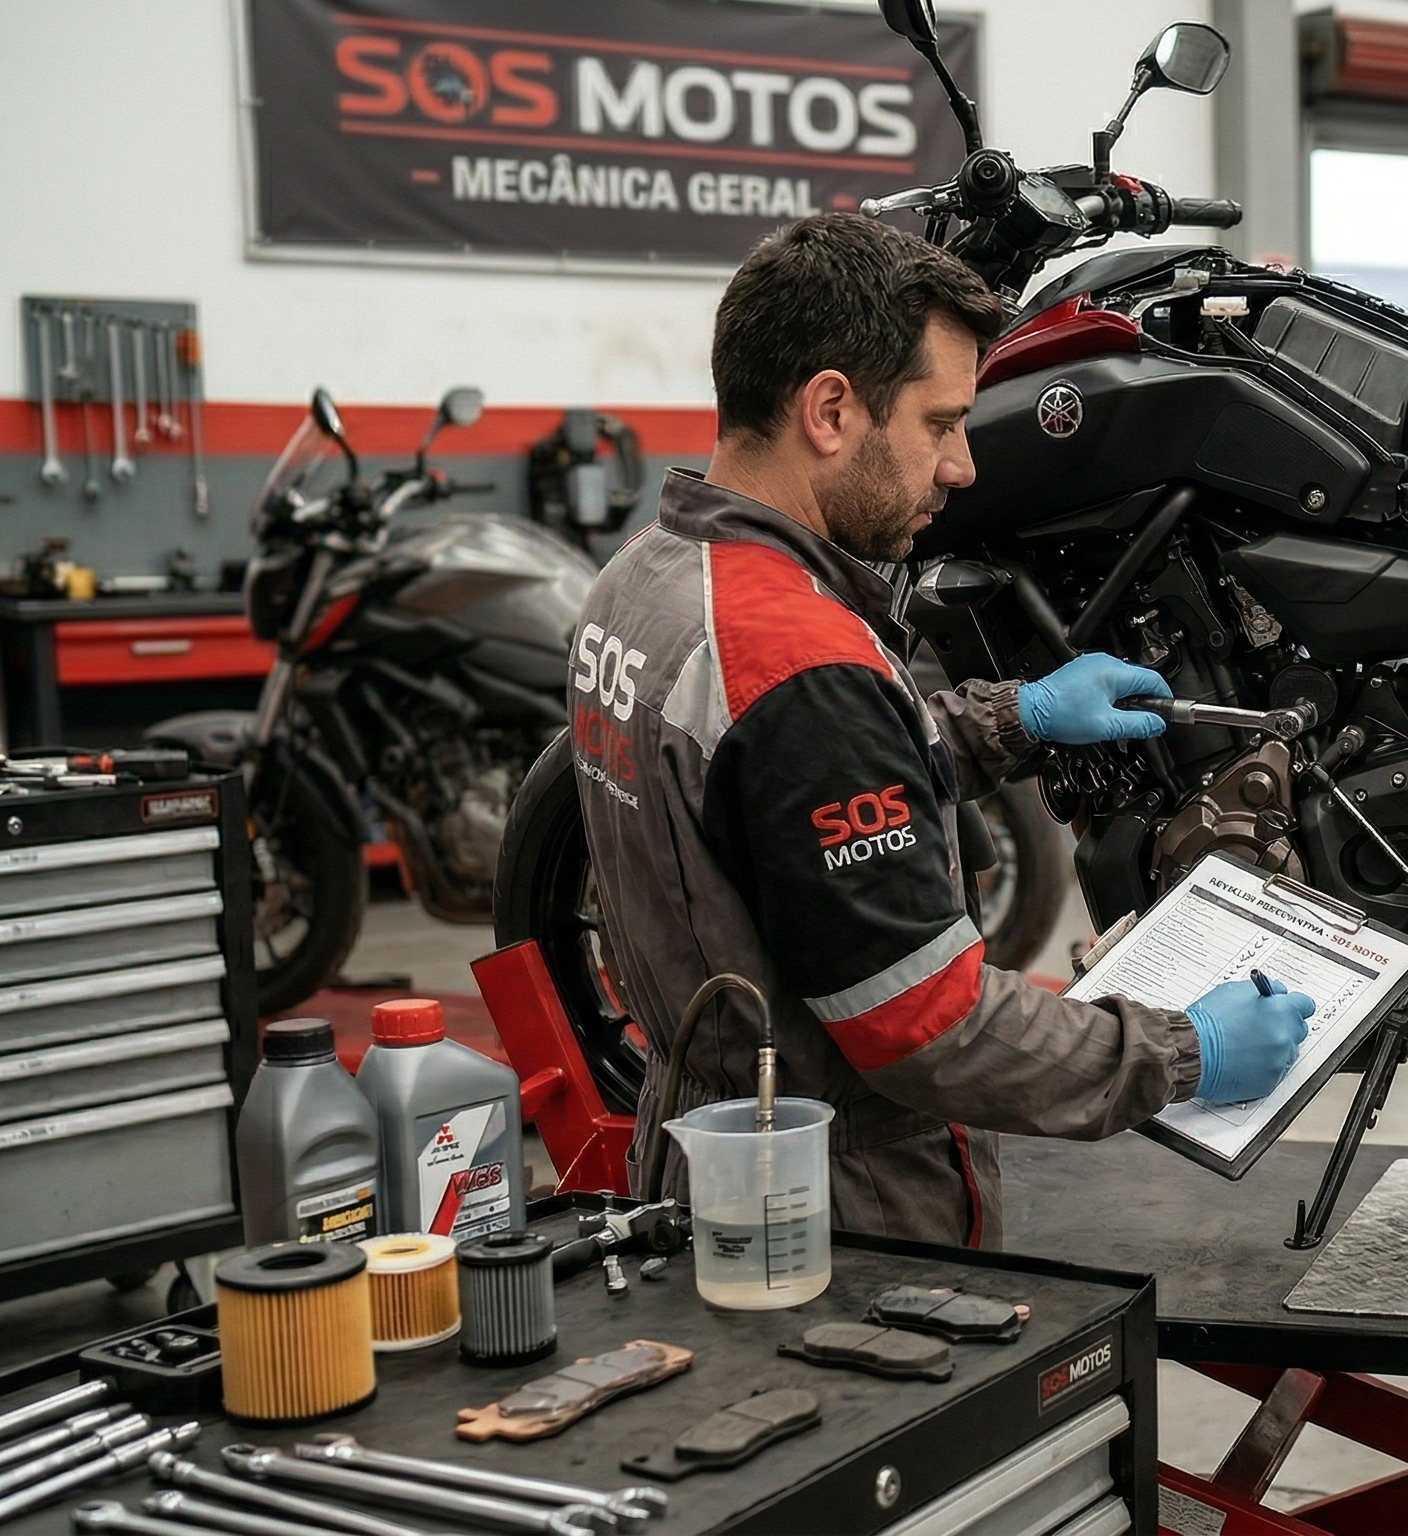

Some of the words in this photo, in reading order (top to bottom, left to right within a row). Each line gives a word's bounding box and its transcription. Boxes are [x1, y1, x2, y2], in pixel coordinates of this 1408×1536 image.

[334, 35, 560, 129] SOS
[576, 56, 918, 157] MOTOS
[451, 153, 678, 211] MECÂNICA
[687, 174, 823, 218] GERAL
[573, 622, 648, 722] SOS
[811, 784, 912, 849] SOS
[823, 825, 918, 871] MOTOS
[1070, 1344, 1111, 1383] MOTOS
